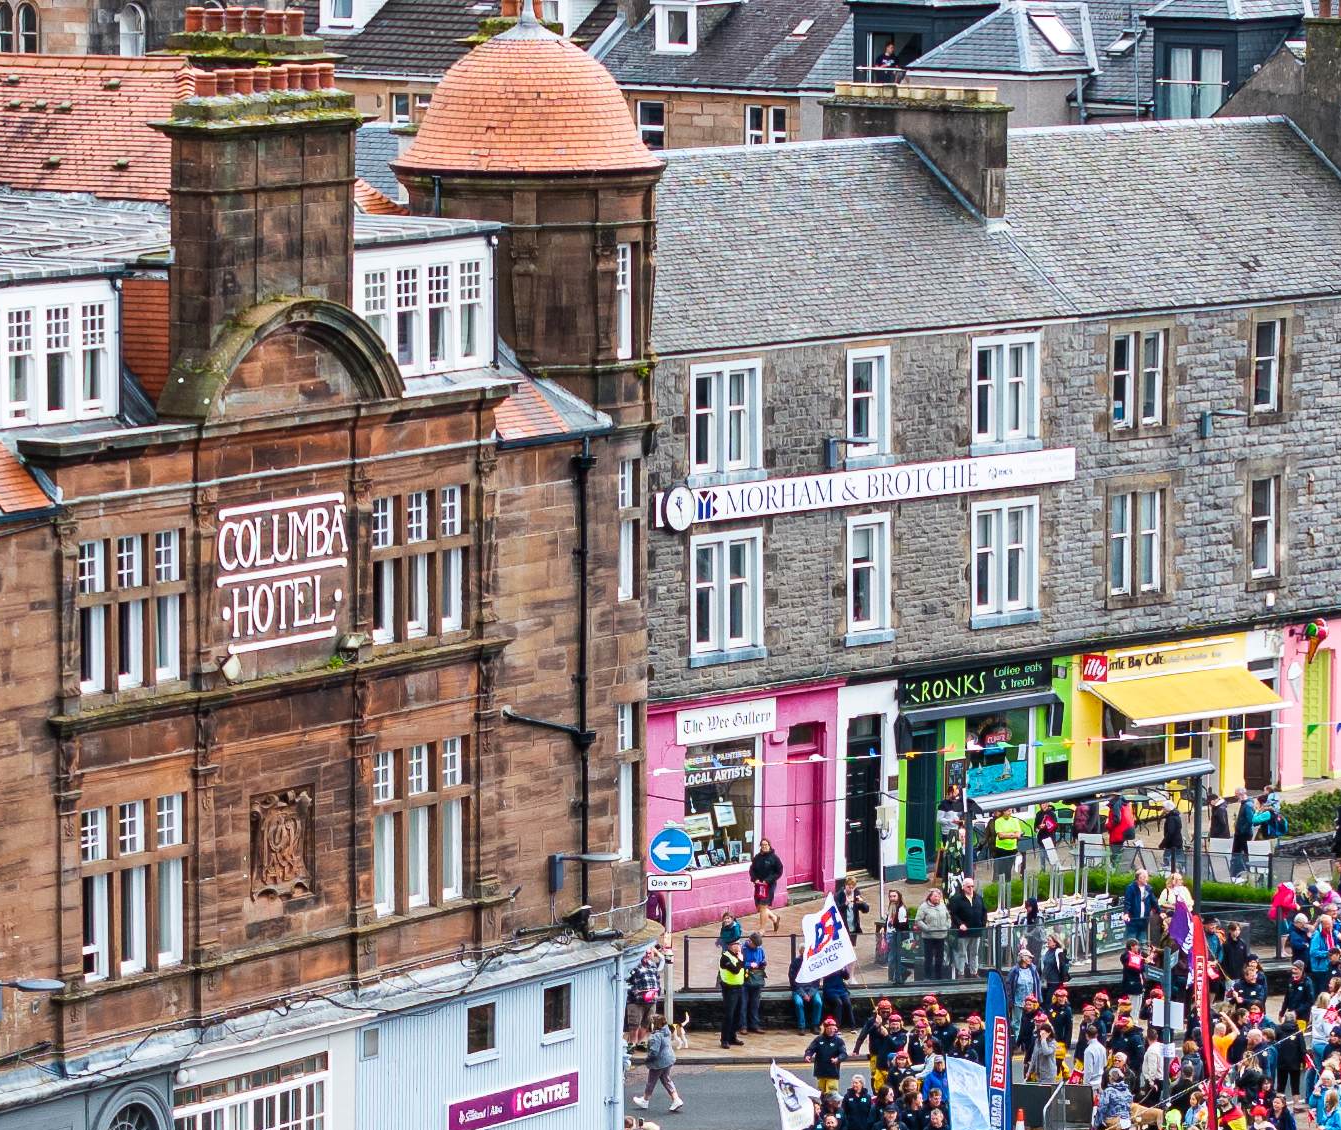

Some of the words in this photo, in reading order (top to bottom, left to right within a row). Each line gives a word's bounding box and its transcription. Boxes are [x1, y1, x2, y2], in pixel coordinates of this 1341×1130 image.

[727, 478, 833, 515] MORHAM
[842, 480, 859, 501] &
[867, 463, 979, 499] BROTCHIE
[218, 504, 348, 571] COLUMBA
[232, 575, 336, 638] HOTEL
[1084, 658, 1107, 681] illy
[1128, 658, 1143, 671] Bay
[905, 671, 986, 704] KRONKS
[994, 664, 1020, 678] Coffee
[1025, 661, 1043, 673] eats
[1011, 676, 1035, 688] treats
[683, 719, 704, 735] The
[707, 715, 730, 730] Wee
[732, 711, 771, 728] Gallery
[684, 771, 712, 787] LOCAL
[714, 766, 753, 782] ARTISTS
[651, 879, 668, 888] One
[671, 879, 688, 889] way
[992, 1022, 1007, 1084] CLIPPER
